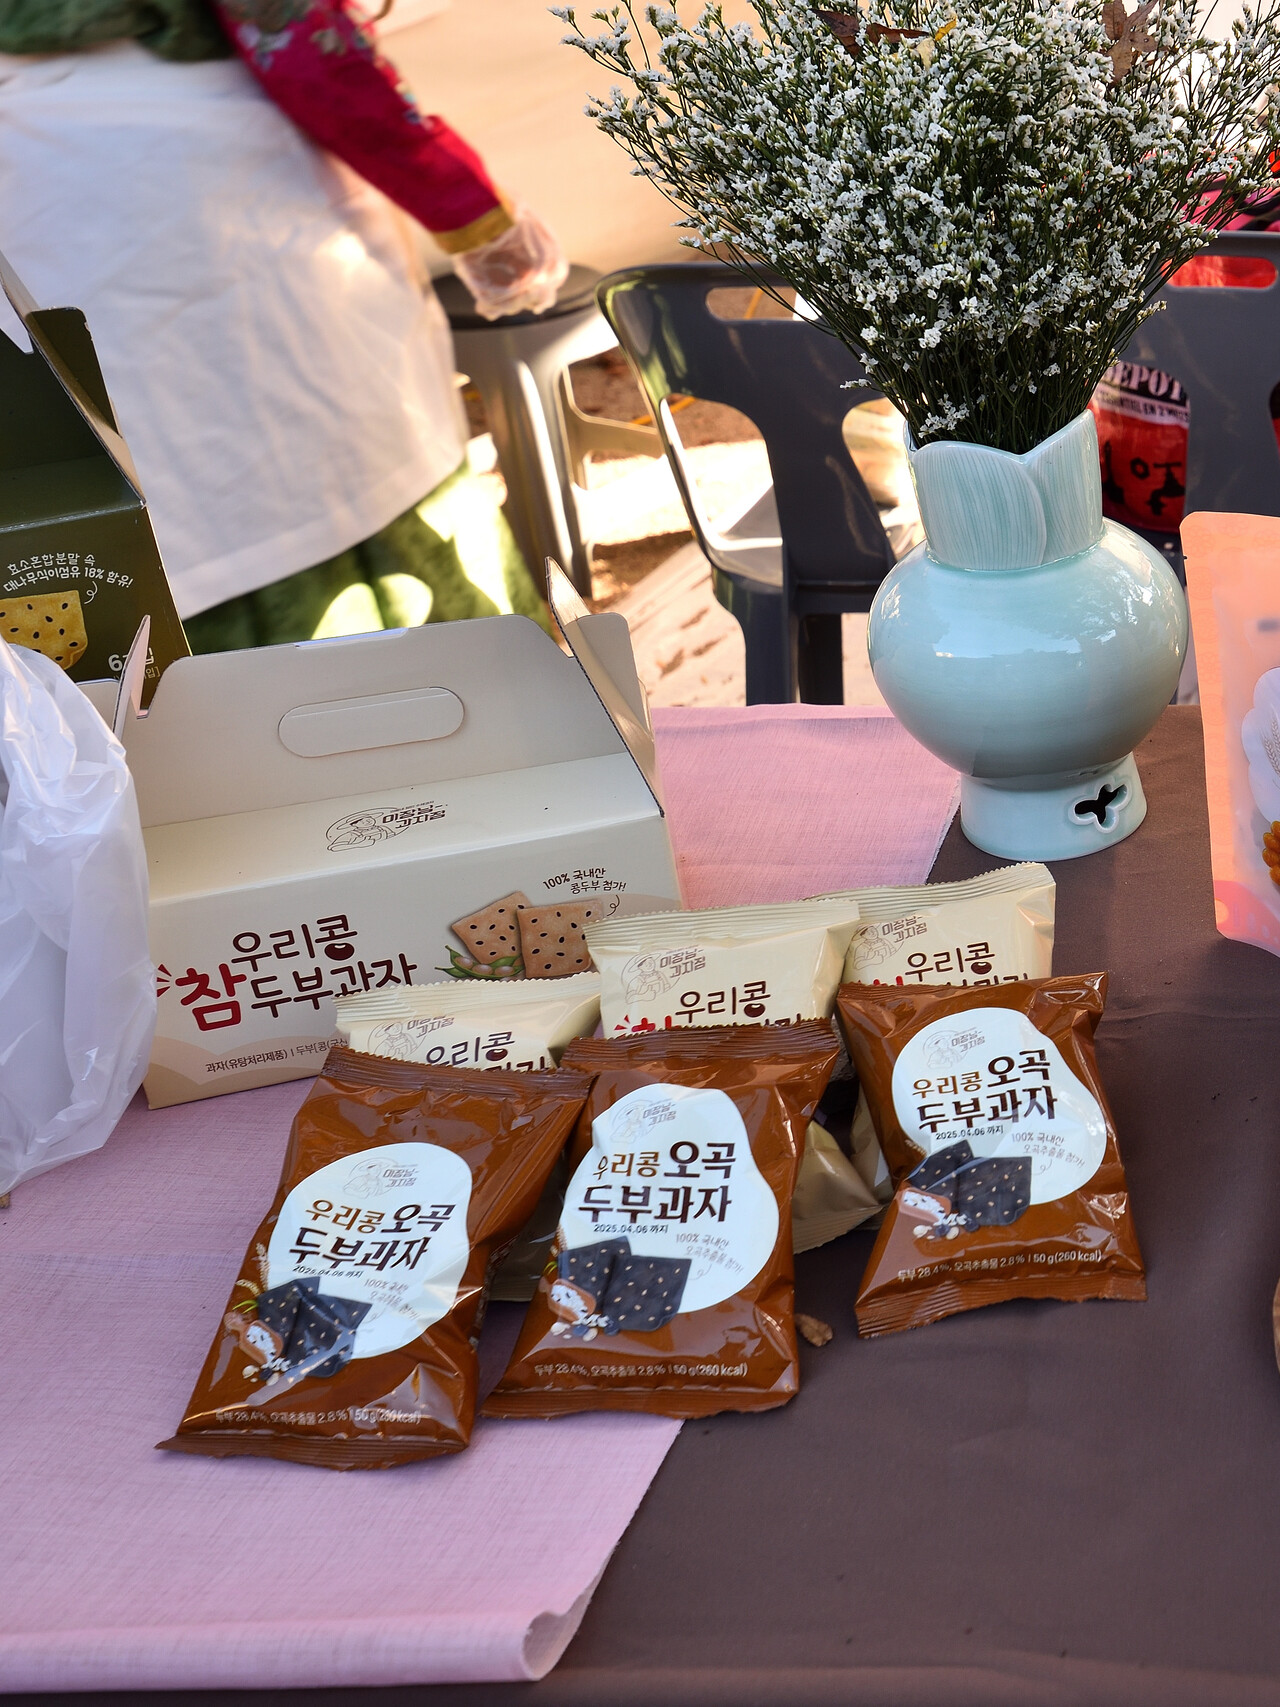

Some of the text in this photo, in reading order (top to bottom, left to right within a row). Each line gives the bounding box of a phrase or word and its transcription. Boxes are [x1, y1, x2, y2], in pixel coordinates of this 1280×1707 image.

[84, 554, 95, 566] 속
[3, 566, 133, 592] 대나무식이섬유 18% 함유!
[543, 868, 606, 889] 100% 국내산
[571, 880, 626, 894] 콩두부 첨가!
[231, 914, 358, 972] 우리콩
[904, 941, 995, 982] 우리콩
[675, 980, 771, 1024] 우리콩
[205, 1048, 288, 1073] 과자(유탕처리제품)
[426, 1031, 515, 1066] 우리콩
[912, 1049, 1050, 1099] 우리콩 오곡
[917, 1085, 1058, 1134] 두부과자
[936, 1128, 985, 1141] 2025.04.06
[593, 1141, 736, 1180] 우리콩 오곡
[305, 1199, 456, 1234] 우리콩 오곡
[578, 1185, 732, 1224] 두부과자
[593, 1224, 648, 1234] 2025.04.06
[289, 1227, 432, 1271] 두부과자
[1000, 1255, 1025, 1267] 2.8%
